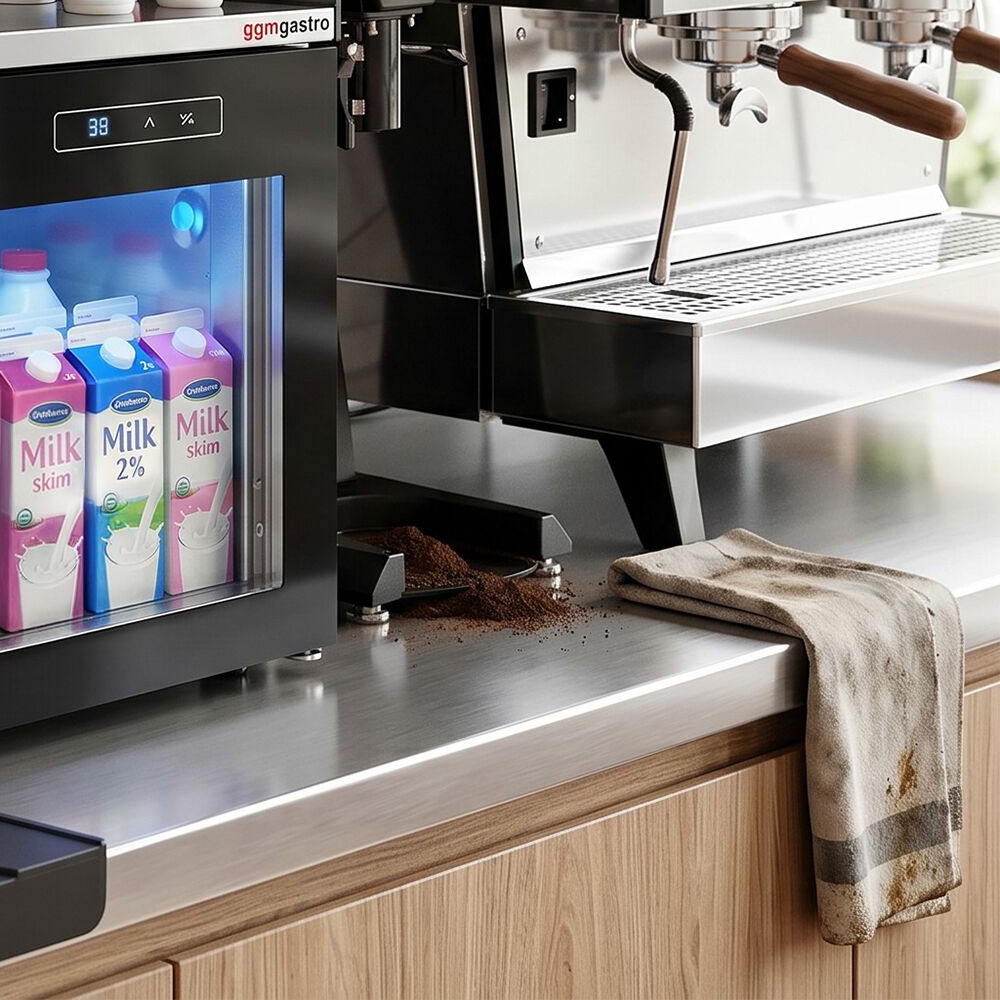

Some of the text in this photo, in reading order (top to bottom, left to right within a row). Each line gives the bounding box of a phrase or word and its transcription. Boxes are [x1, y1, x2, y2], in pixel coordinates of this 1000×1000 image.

[243, 16, 330, 41] ggmgastro
[176, 405, 229, 441] Milk
[103, 418, 157, 456] Milk
[186, 439, 220, 459] skim
[20, 431, 82, 472] Milk
[116, 455, 145, 481] 2%
[32, 471, 71, 493] skim
